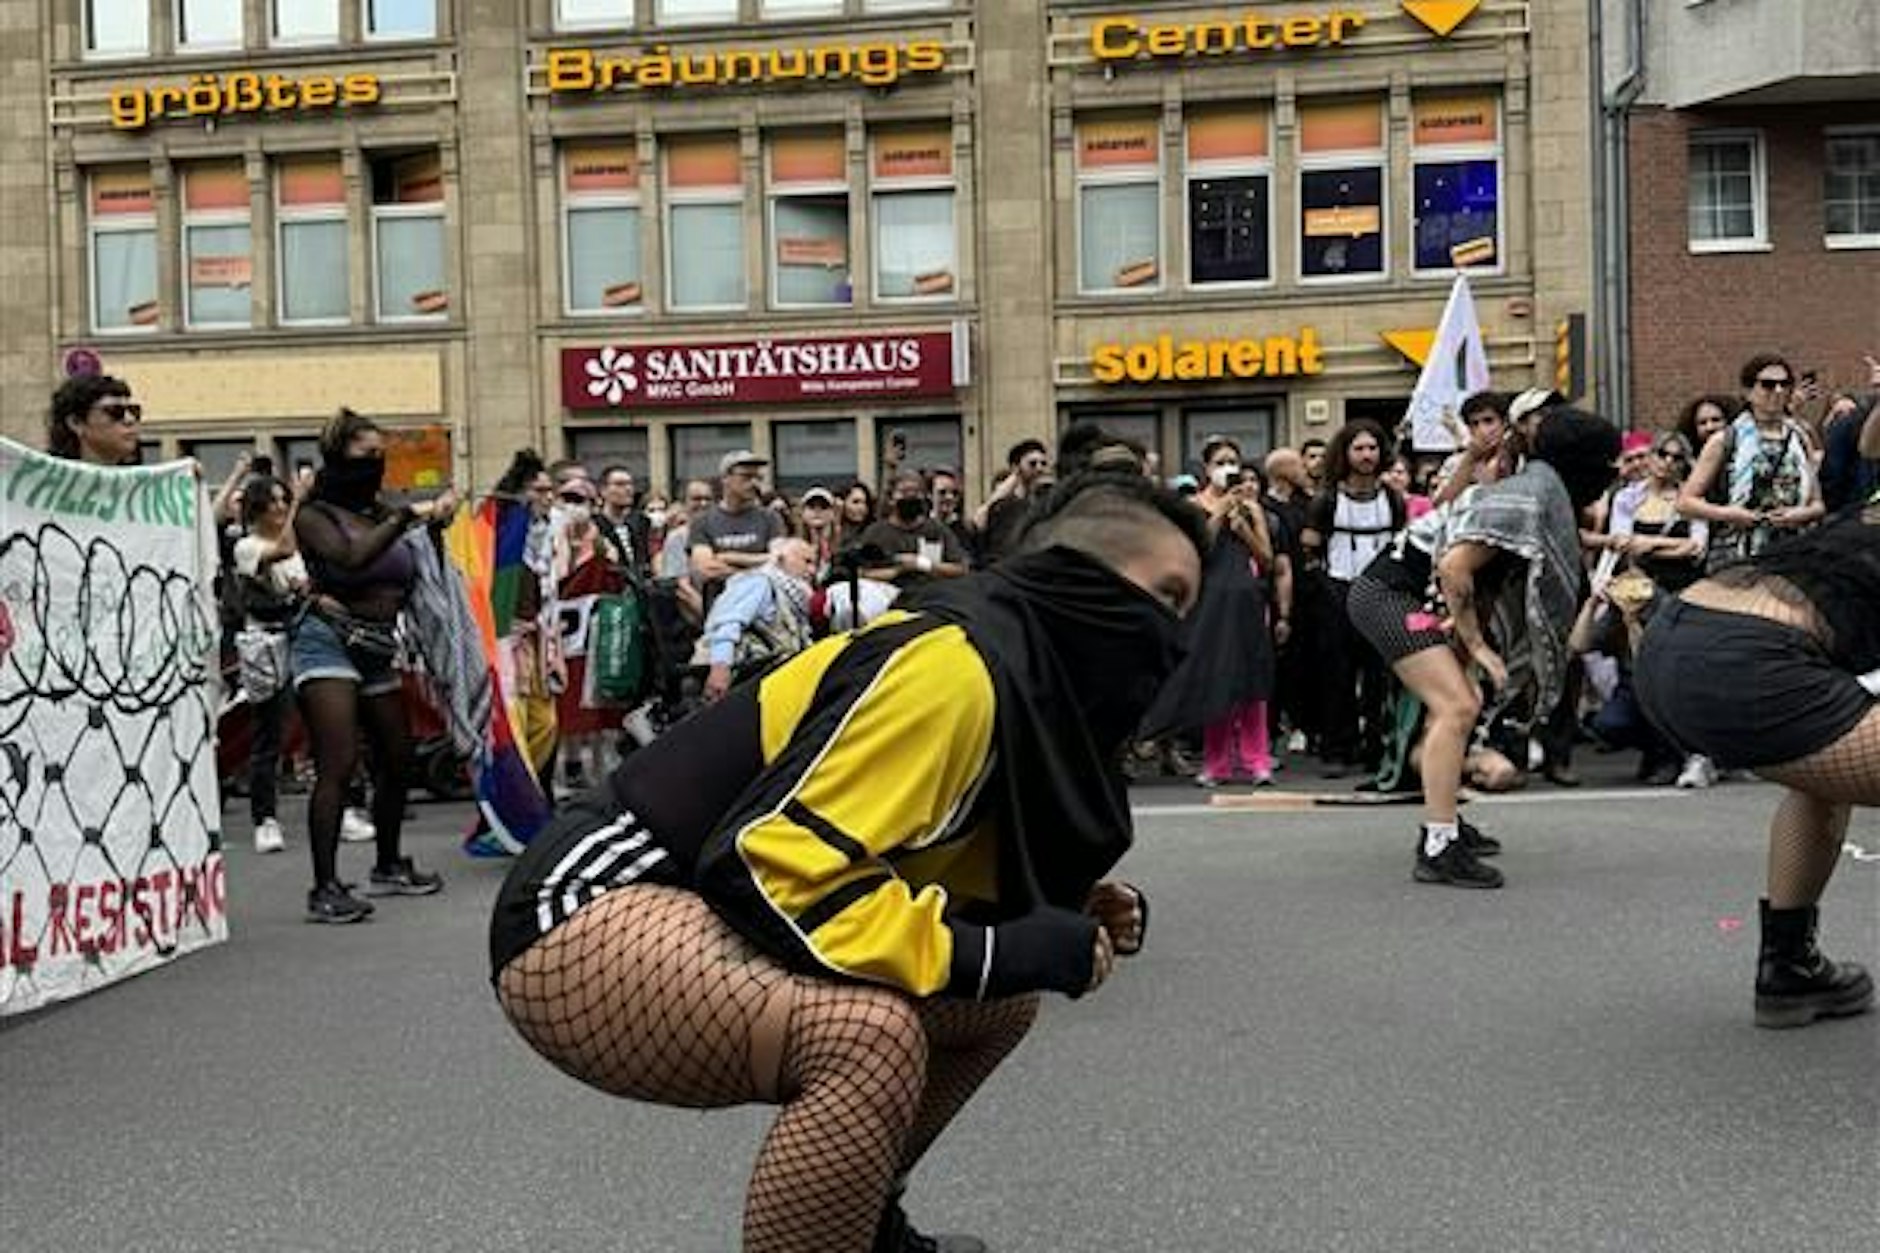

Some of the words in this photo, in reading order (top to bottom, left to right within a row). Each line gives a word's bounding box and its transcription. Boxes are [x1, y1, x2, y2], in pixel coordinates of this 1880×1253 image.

[1091, 9, 1366, 58] Center
[548, 38, 943, 91] Bräunungs
[111, 70, 379, 128] größtes
[646, 339, 921, 381] SANITÄTSHAUS
[1093, 326, 1325, 382] solarent
[685, 381, 735, 398] GmbH
[6, 454, 195, 527] PALESTINE
[0, 888, 37, 968] L
